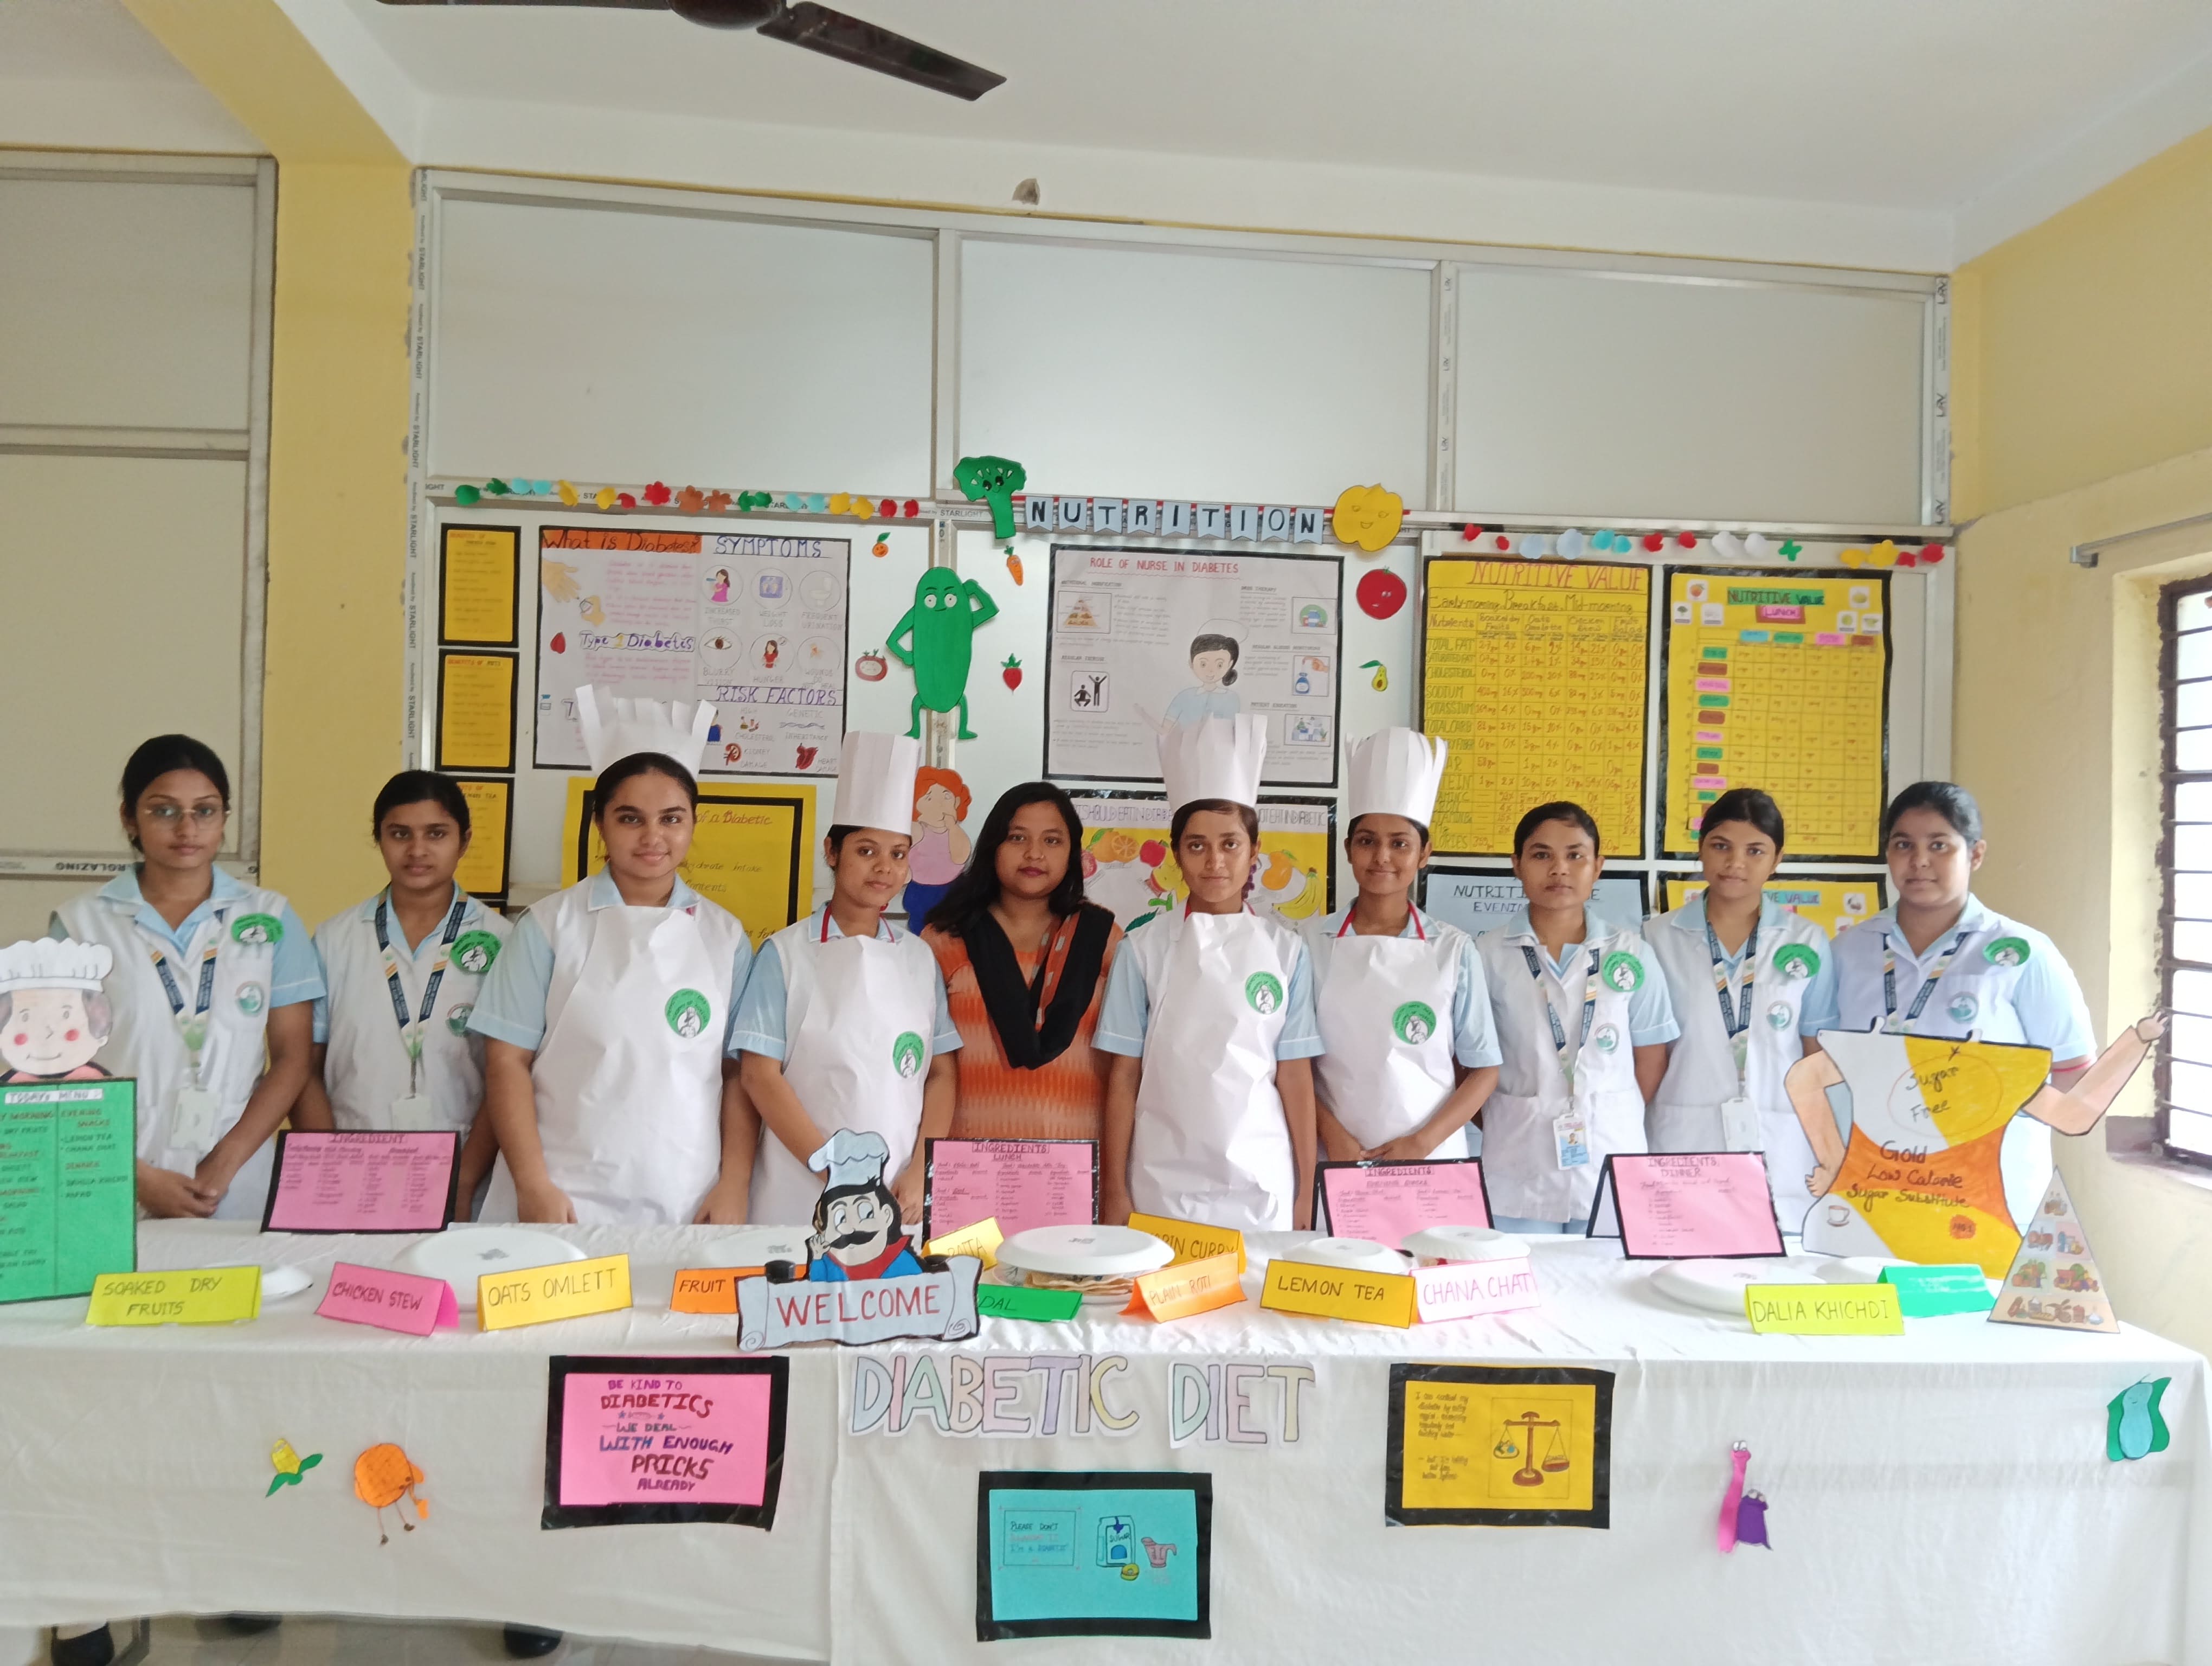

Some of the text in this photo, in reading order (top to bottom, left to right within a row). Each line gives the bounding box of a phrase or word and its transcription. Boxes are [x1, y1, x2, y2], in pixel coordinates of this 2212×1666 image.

[1031, 501, 1315, 534] NUTRITION
[542, 529, 590, 550] What
[600, 531, 618, 550] is
[715, 535, 822, 558] SYMPTOMS
[1090, 557, 1239, 573] ROLE OF NURSE IN DIABETES
[1470, 562, 1644, 591] NUTRITIVE VALUE
[763, 619, 783, 628] LOSS
[580, 632, 608, 648] Type
[716, 685, 837, 706] RISK FACTORS
[786, 709, 824, 719] GENETIC
[723, 810, 773, 825] Diabetic
[1454, 885, 1527, 899] NUTRITI
[1474, 902, 1525, 913] EVENIN
[1906, 1066, 1960, 1093] Sugar
[1909, 1099, 1951, 1123] Free
[974, 1142, 1047, 1154] INGREDIENTS
[1880, 1140, 1928, 1164] Gold
[1366, 1167, 1432, 1177] INGREDIENTS
[1647, 1157, 1718, 1167] INGREDIENTS
[1867, 1163, 1901, 1180] Low
[1660, 1169, 1702, 1177] DINNER
[1846, 1183, 1889, 1212] Sugar
[102, 1277, 223, 1297] SOAKED DRY
[332, 1281, 423, 1311] CHICKEN STEW
[488, 1267, 617, 1306] OATS OMLETT
[678, 1279, 727, 1293] FRUIT
[1149, 1274, 1212, 1306] PLAIN ROTI
[1277, 1275, 1385, 1302] LEMON TEA
[1423, 1273, 1532, 1305] CHANA CHAT
[126, 1301, 185, 1317] FRUITS
[775, 1284, 941, 1328] WELCOME
[978, 1295, 1017, 1311] DAL
[1752, 1299, 1890, 1323] DALIA KHICHDI
[608, 1379, 683, 1390] BE KIND TO
[601, 1393, 714, 1419] DIABETICS
[852, 1355, 1316, 1445] DIABETIC DIET
[616, 1422, 678, 1433] WE DEAL
[599, 1435, 734, 1456] WITH ENOUGH
[631, 1454, 715, 1481] PRICKS
[636, 1478, 696, 1492] ALREADY
[1010, 1521, 1033, 1532] PLEASE
[1109, 1532, 1131, 1543] SUGAR
